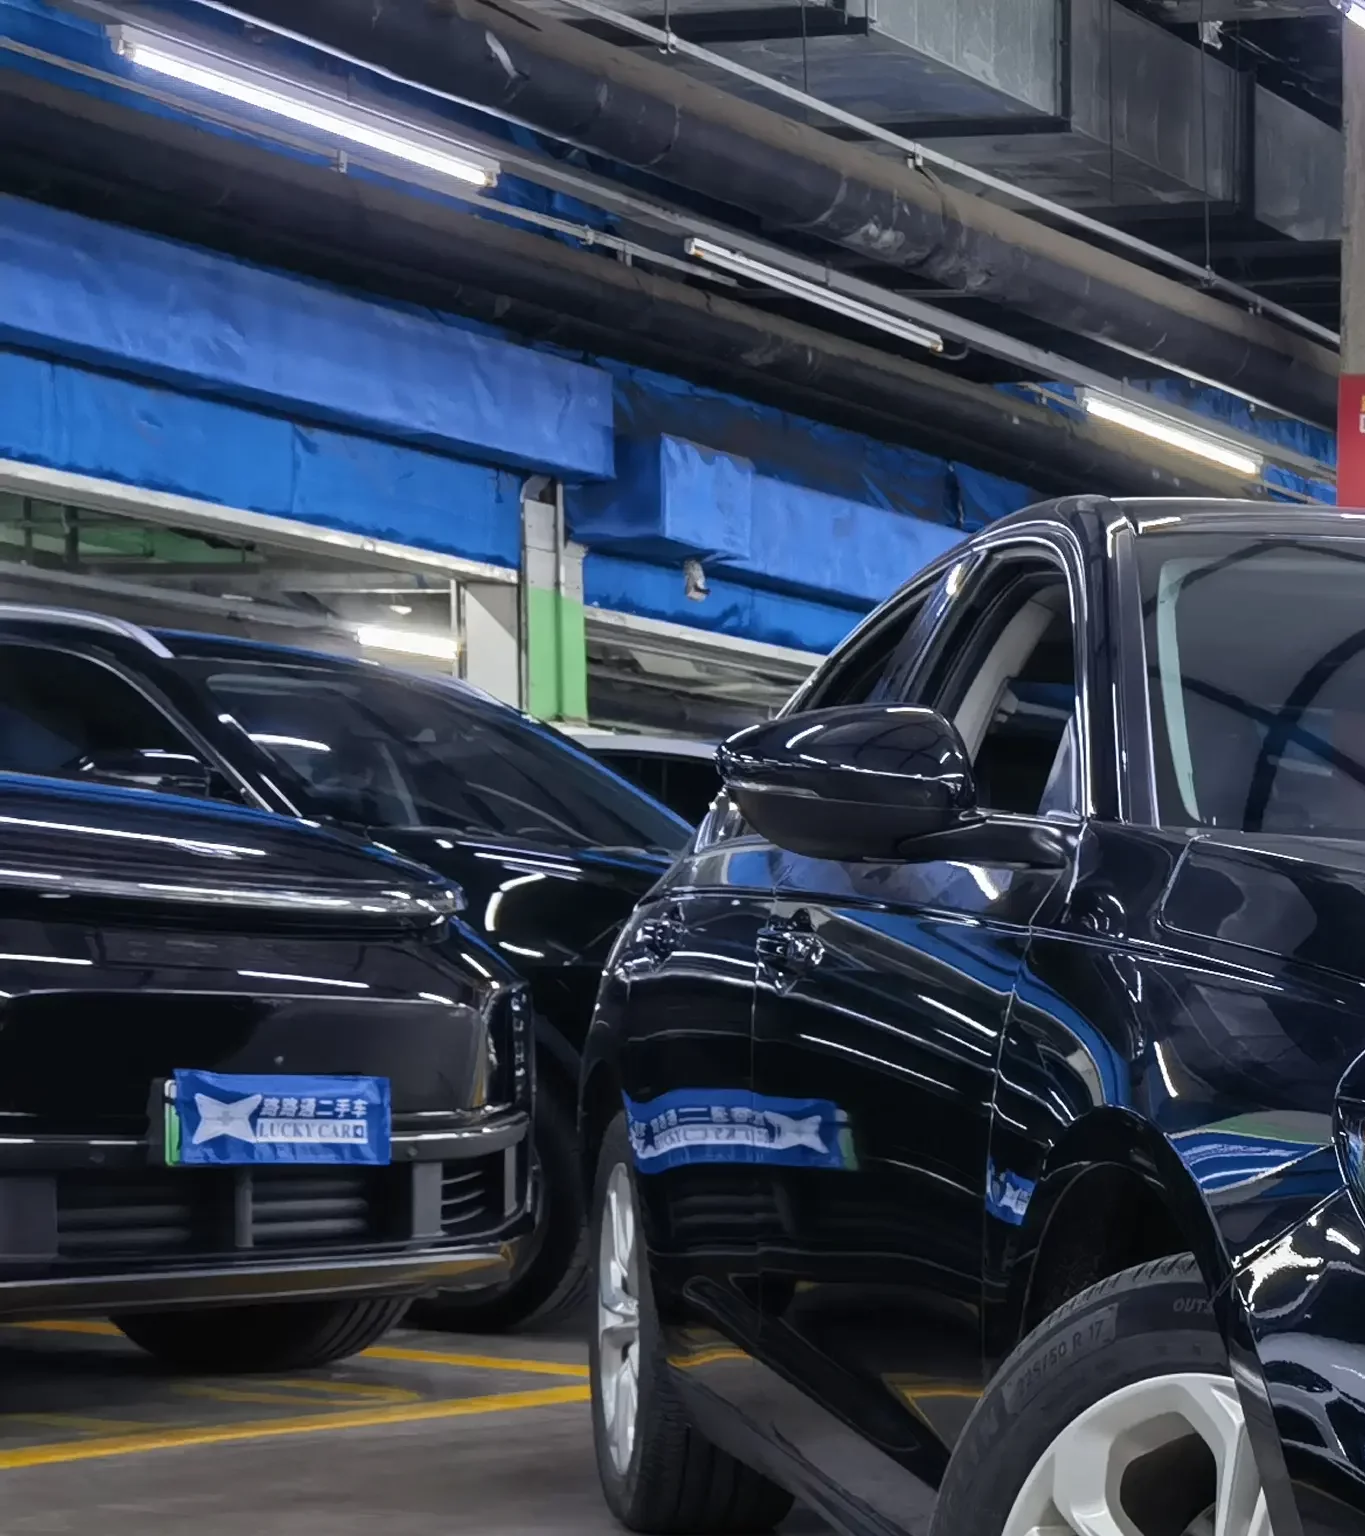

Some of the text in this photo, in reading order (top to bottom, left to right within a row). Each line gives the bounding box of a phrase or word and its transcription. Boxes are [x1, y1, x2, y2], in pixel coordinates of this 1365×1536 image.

[258, 1097, 369, 1119] 路路通二手车
[259, 1120, 350, 1139] LUCKY CAR
[1088, 1319, 1104, 1341] 17
